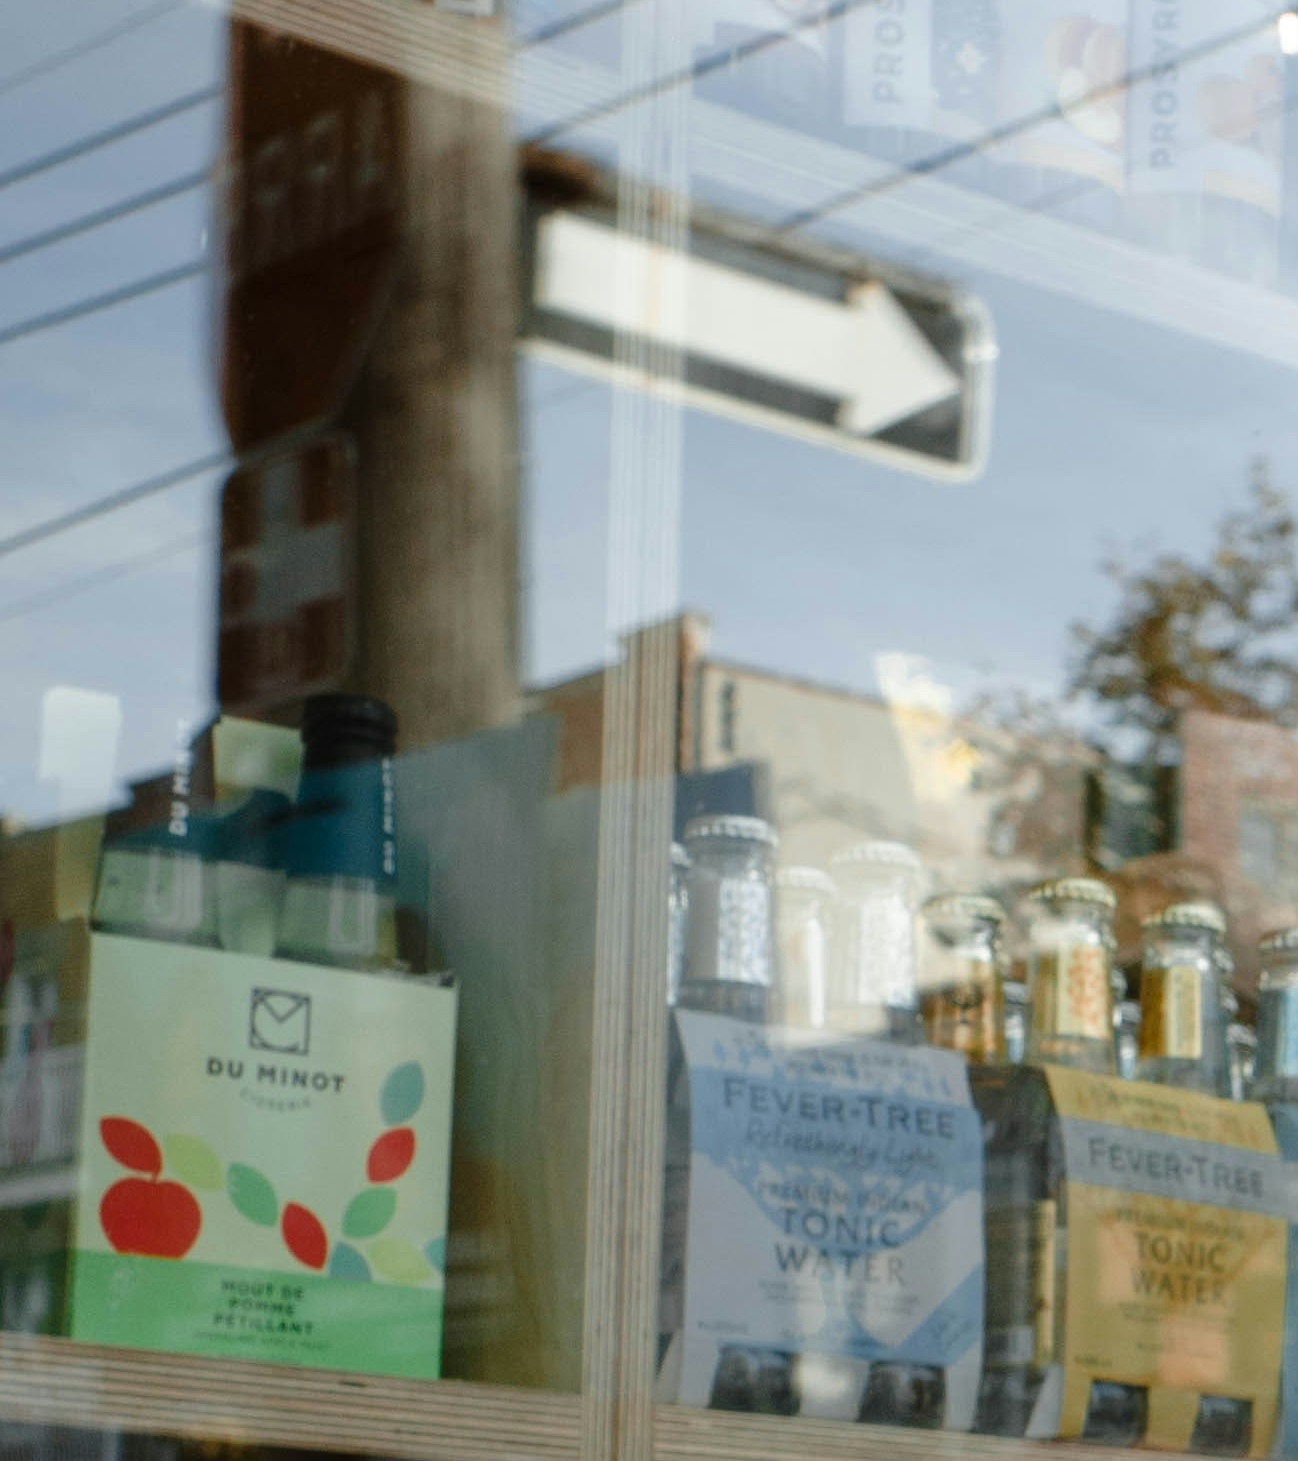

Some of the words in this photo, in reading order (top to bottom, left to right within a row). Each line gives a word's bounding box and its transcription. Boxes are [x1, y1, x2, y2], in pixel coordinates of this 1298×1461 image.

[168, 799, 189, 837] DU
[205, 1054, 245, 1081] DU
[255, 1062, 348, 1095] MINOT
[721, 1076, 956, 1141] FEVER-TREE
[1087, 1136, 1265, 1200] FEVER-TREE
[778, 1207, 903, 1249] TONIC
[773, 1242, 906, 1288] WATER
[1134, 1230, 1227, 1274] TONIC
[1130, 1265, 1228, 1307] WATER
